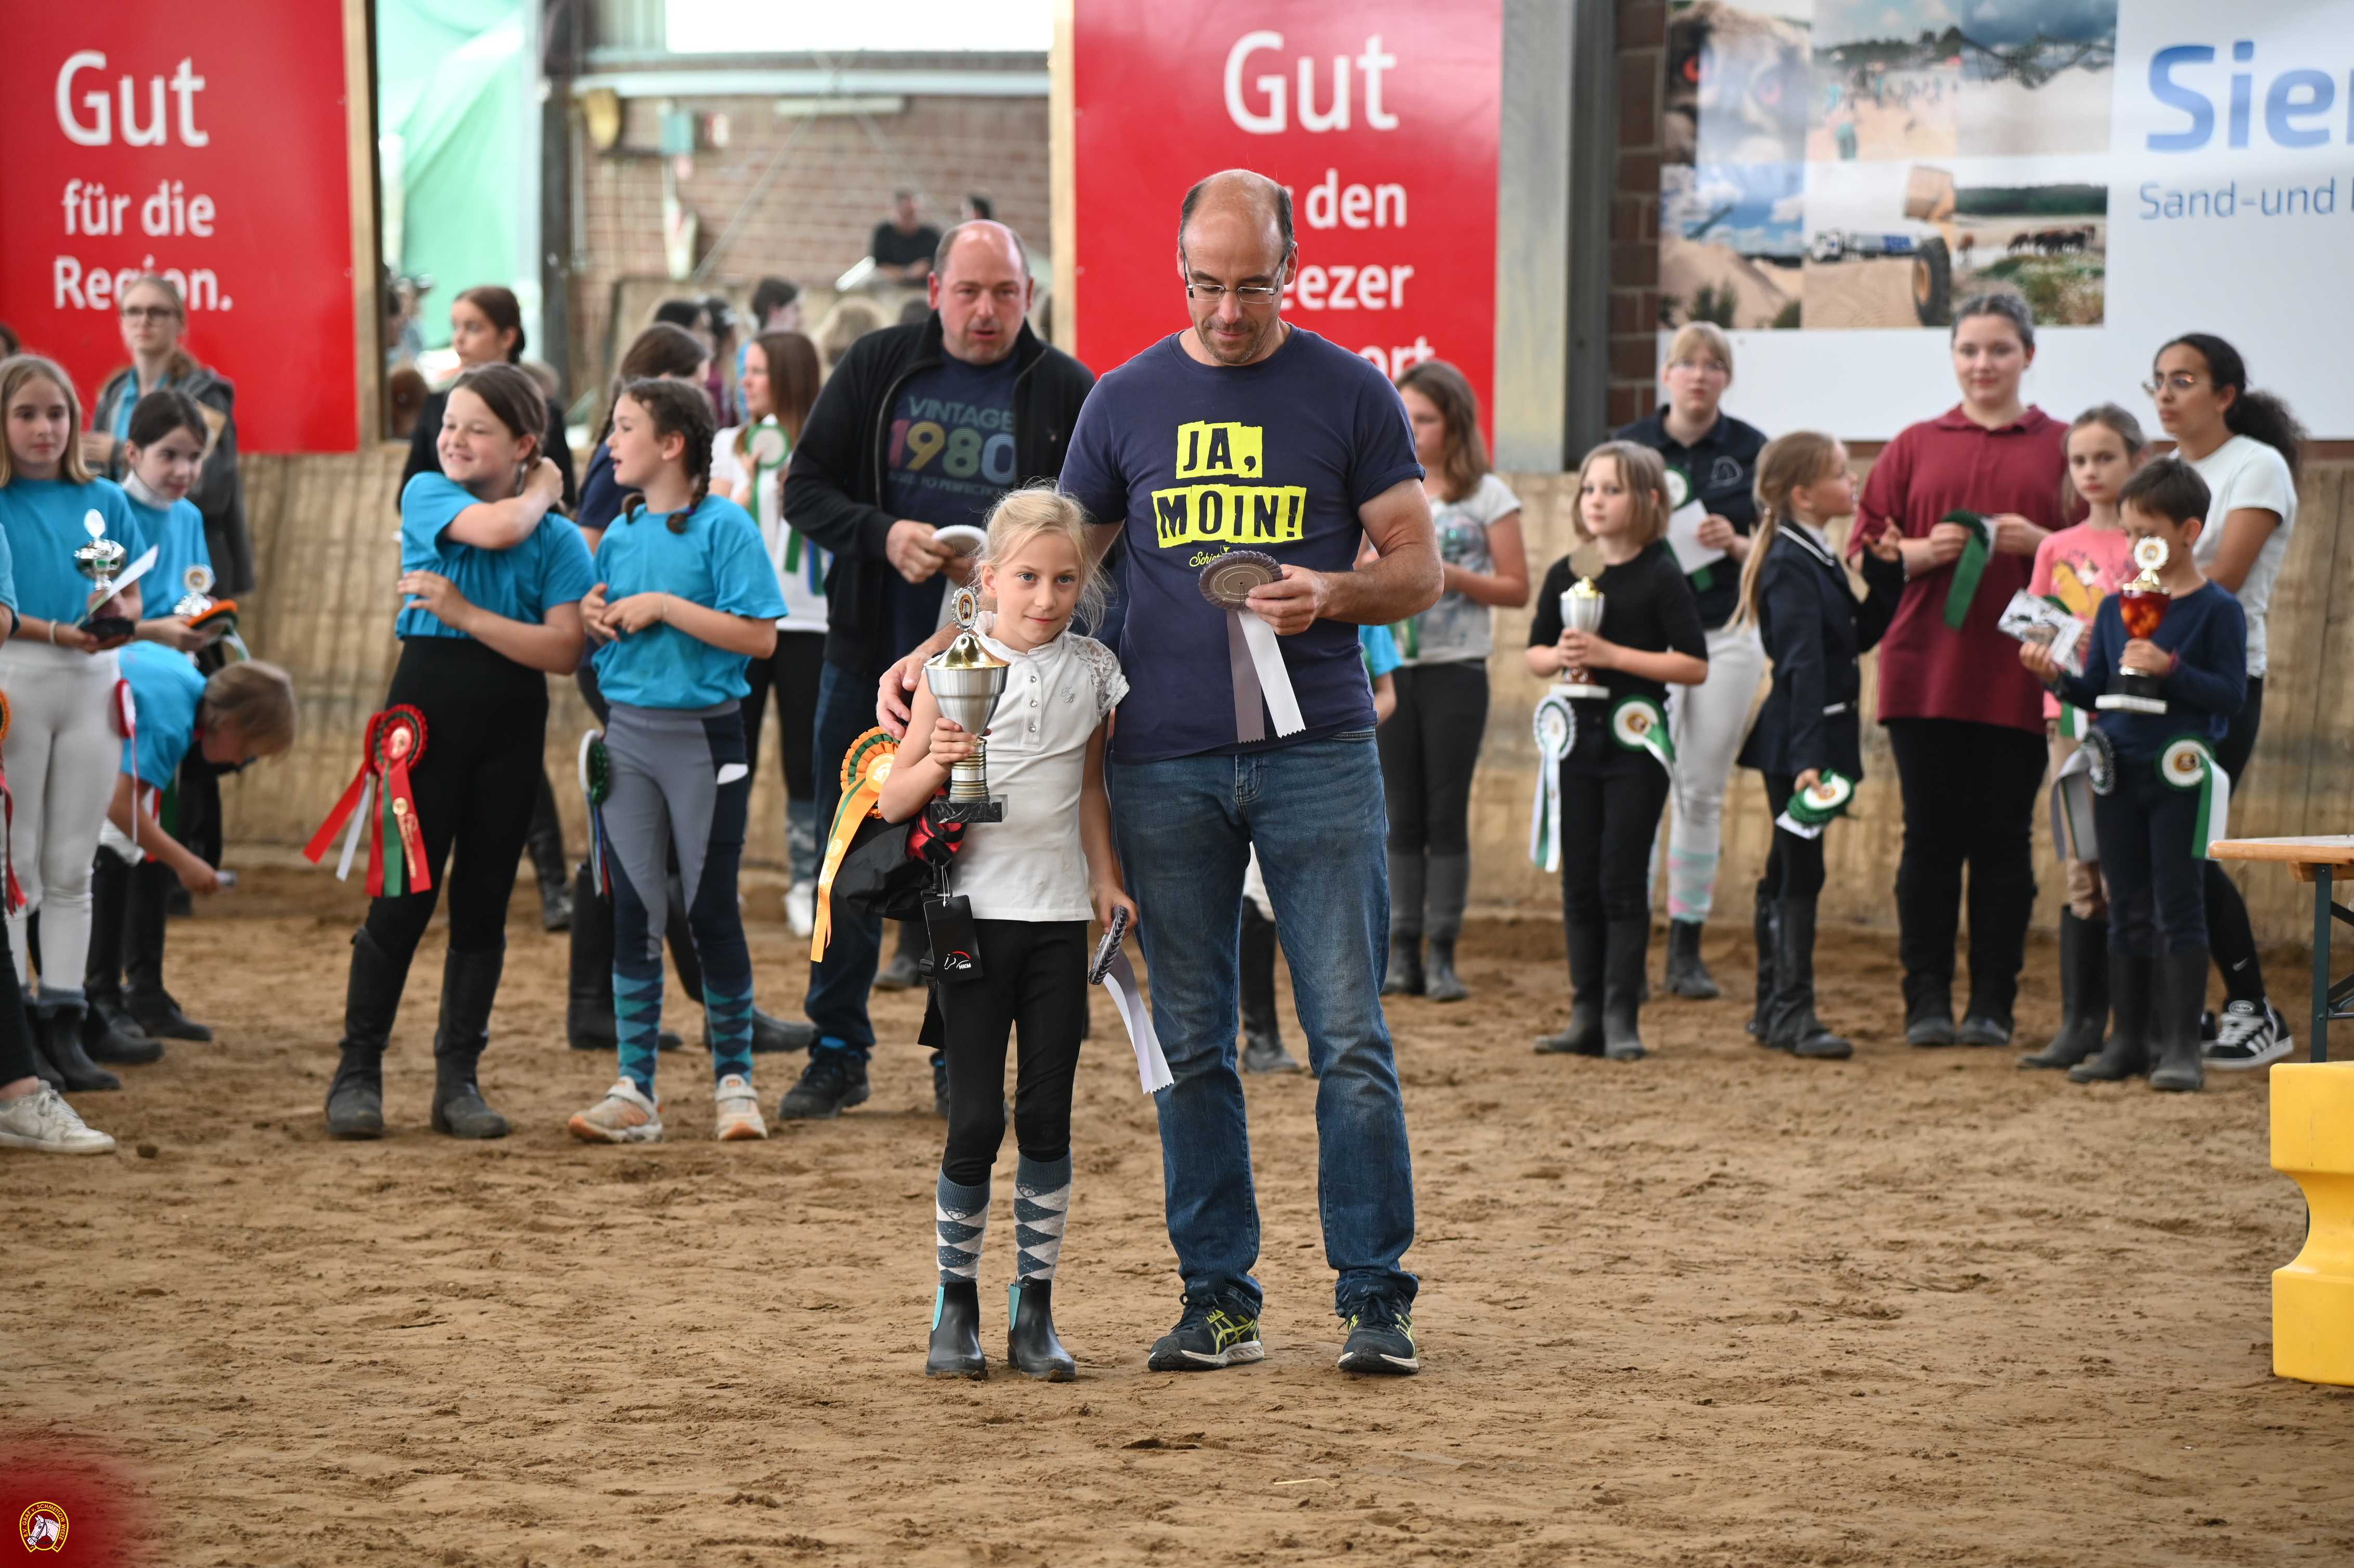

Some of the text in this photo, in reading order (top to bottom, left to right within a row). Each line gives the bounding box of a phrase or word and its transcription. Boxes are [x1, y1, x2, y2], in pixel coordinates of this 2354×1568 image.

[55, 49, 210, 147] Gut
[1223, 30, 1400, 134] Gut
[2146, 40, 2354, 153] Sie
[62, 178, 215, 238] für die
[1305, 168, 1407, 230] den
[54, 254, 233, 312] Reon.
[908, 396, 1015, 432] VINTAGE
[888, 419, 1015, 485] 1980
[1183, 427, 1256, 472] JA,
[1157, 490, 1300, 539] MOIN!
